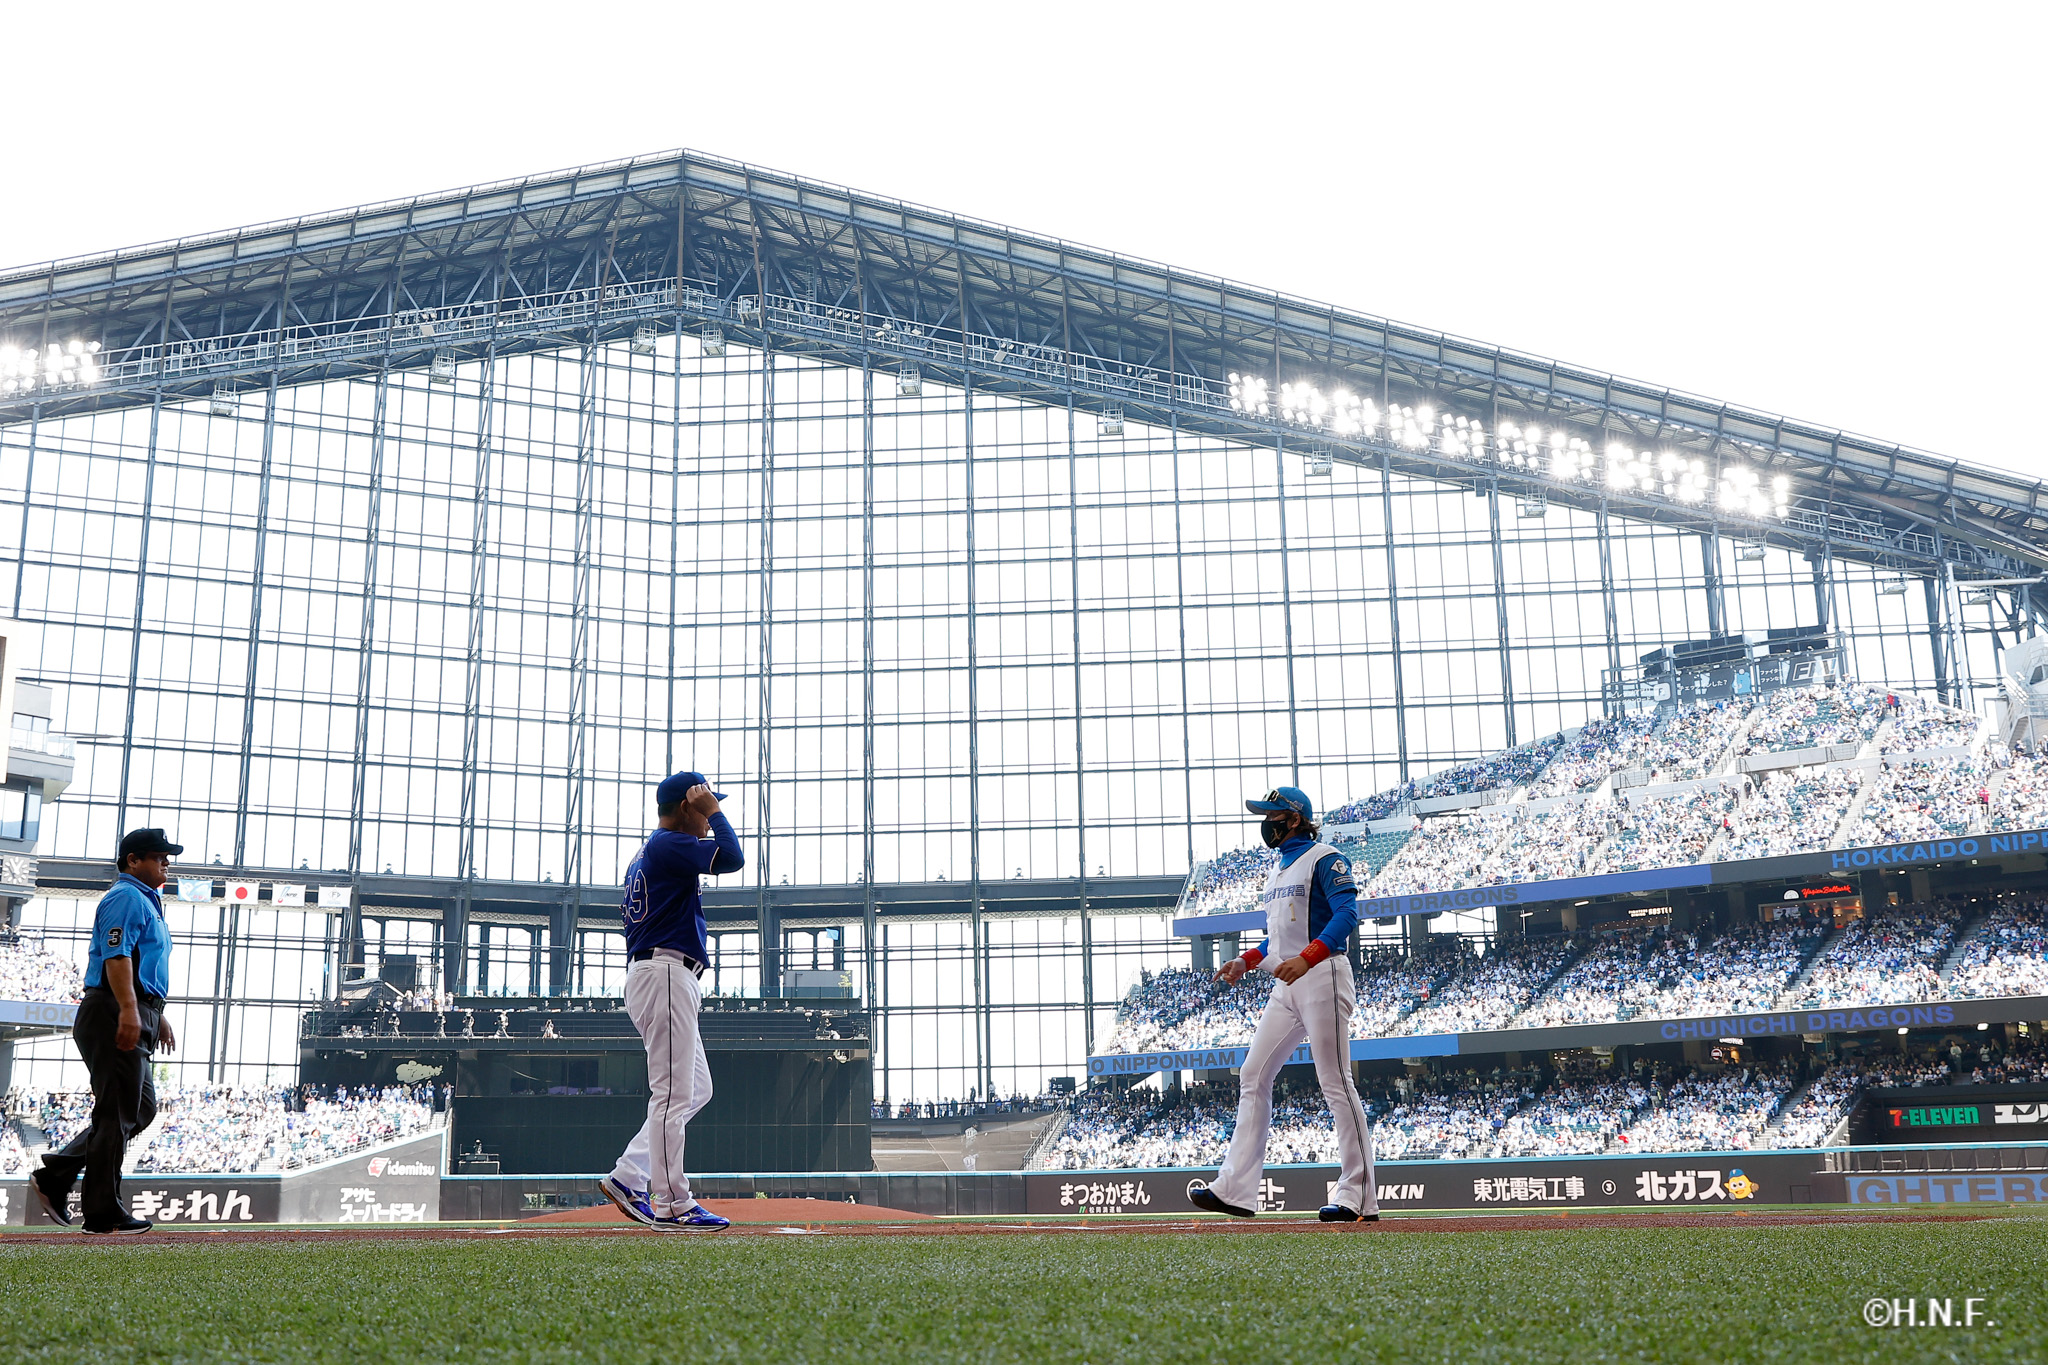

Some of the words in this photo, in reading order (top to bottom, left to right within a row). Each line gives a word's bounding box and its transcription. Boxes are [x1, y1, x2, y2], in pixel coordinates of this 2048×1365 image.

[1832, 839, 1979, 869] HOKKAIDO
[1409, 887, 1518, 910] DRAGONS
[108, 927, 123, 947] 3
[1660, 1015, 1796, 1040] CHUNICHI
[1808, 1005, 1955, 1031] DRAGONS
[1112, 1051, 1236, 1072] NIPPONHAM
[387, 1160, 436, 1176] idemitsu
[340, 1187, 376, 1203] アサヒ
[1060, 1180, 1151, 1206] まつおかまん
[1377, 1184, 1425, 1200] IKIN
[1473, 1176, 1586, 1202] 東光電気工事
[1635, 1170, 1727, 1202] 北ガス
[131, 1189, 254, 1222] ぎょれん
[339, 1203, 428, 1223] スーパードライ
